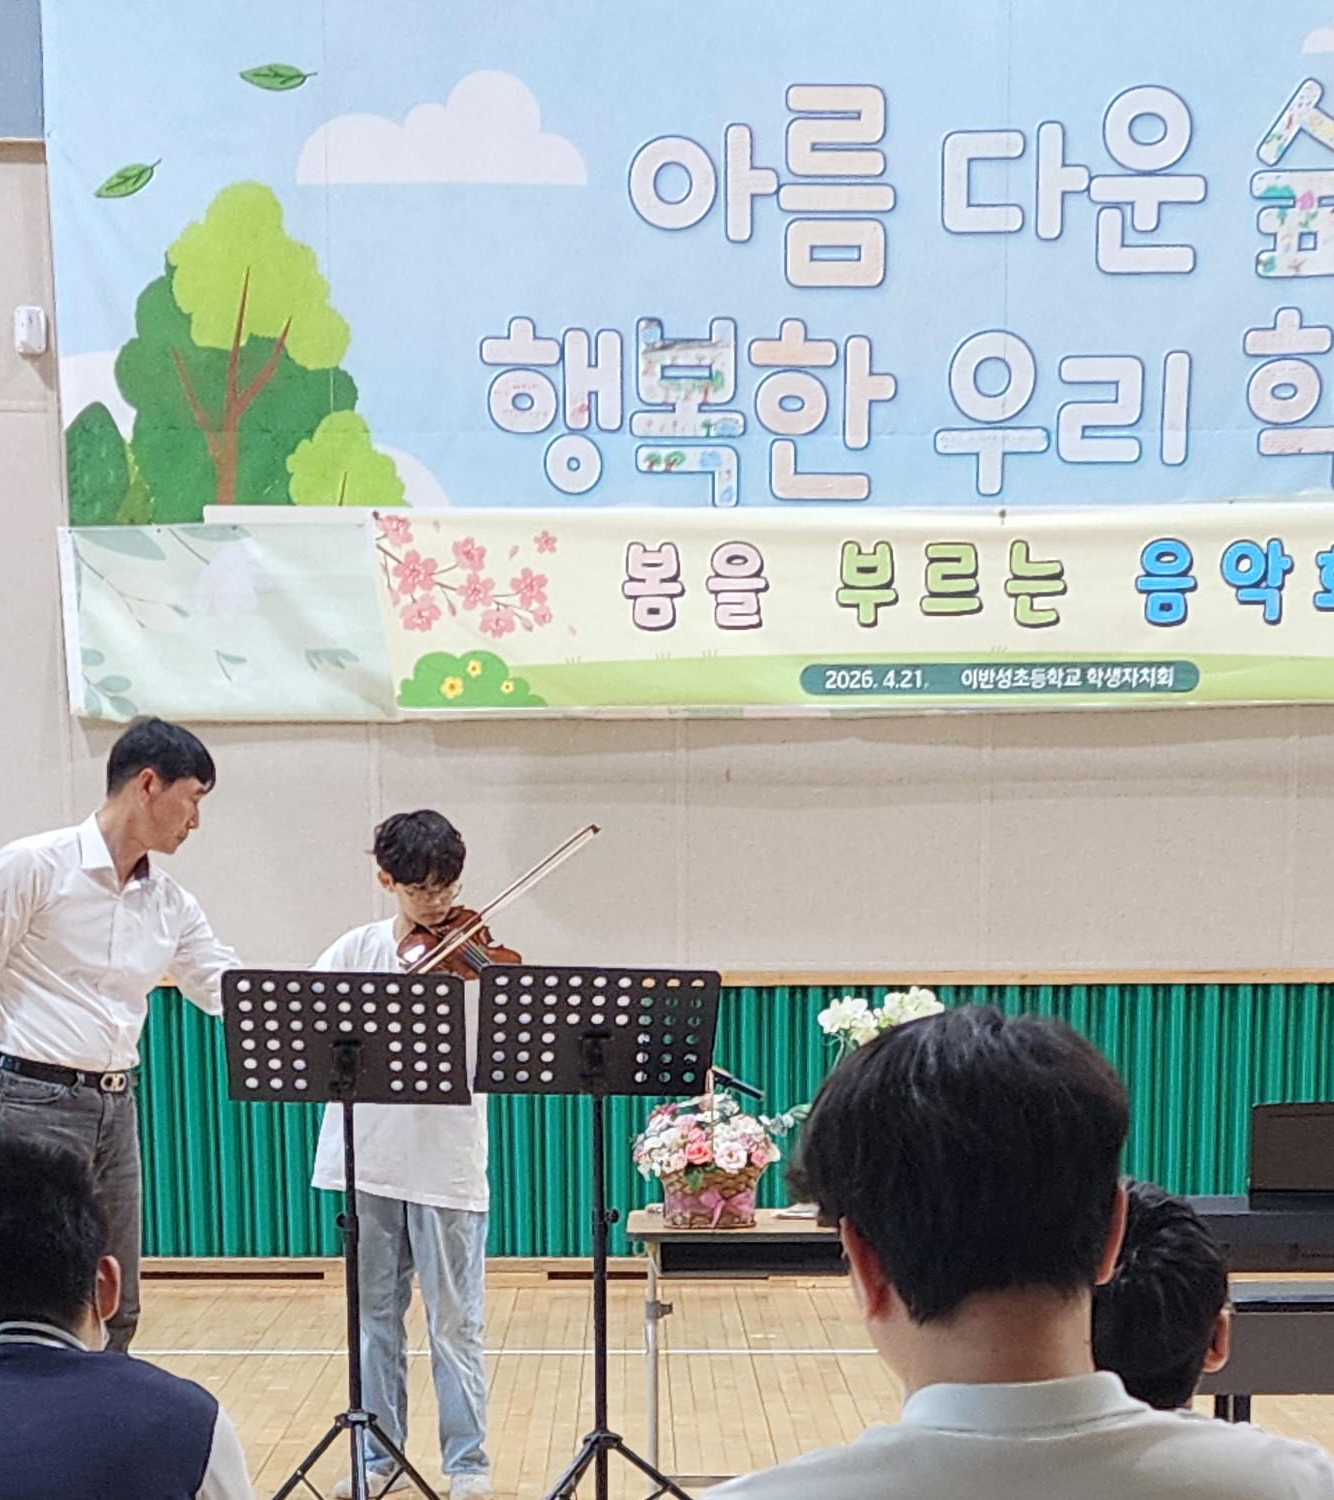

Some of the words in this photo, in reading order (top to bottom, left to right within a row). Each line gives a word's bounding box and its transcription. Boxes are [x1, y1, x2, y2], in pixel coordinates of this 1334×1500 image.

[479, 316, 897, 509] 행복한
[933, 329, 1191, 497] 우리
[621, 540, 769, 631] 봄을
[835, 540, 1068, 629] 부르는
[824, 668, 878, 690] 2026.
[960, 667, 1081, 690] 이반성초등학교
[1087, 665, 1175, 689] 학생자치회
